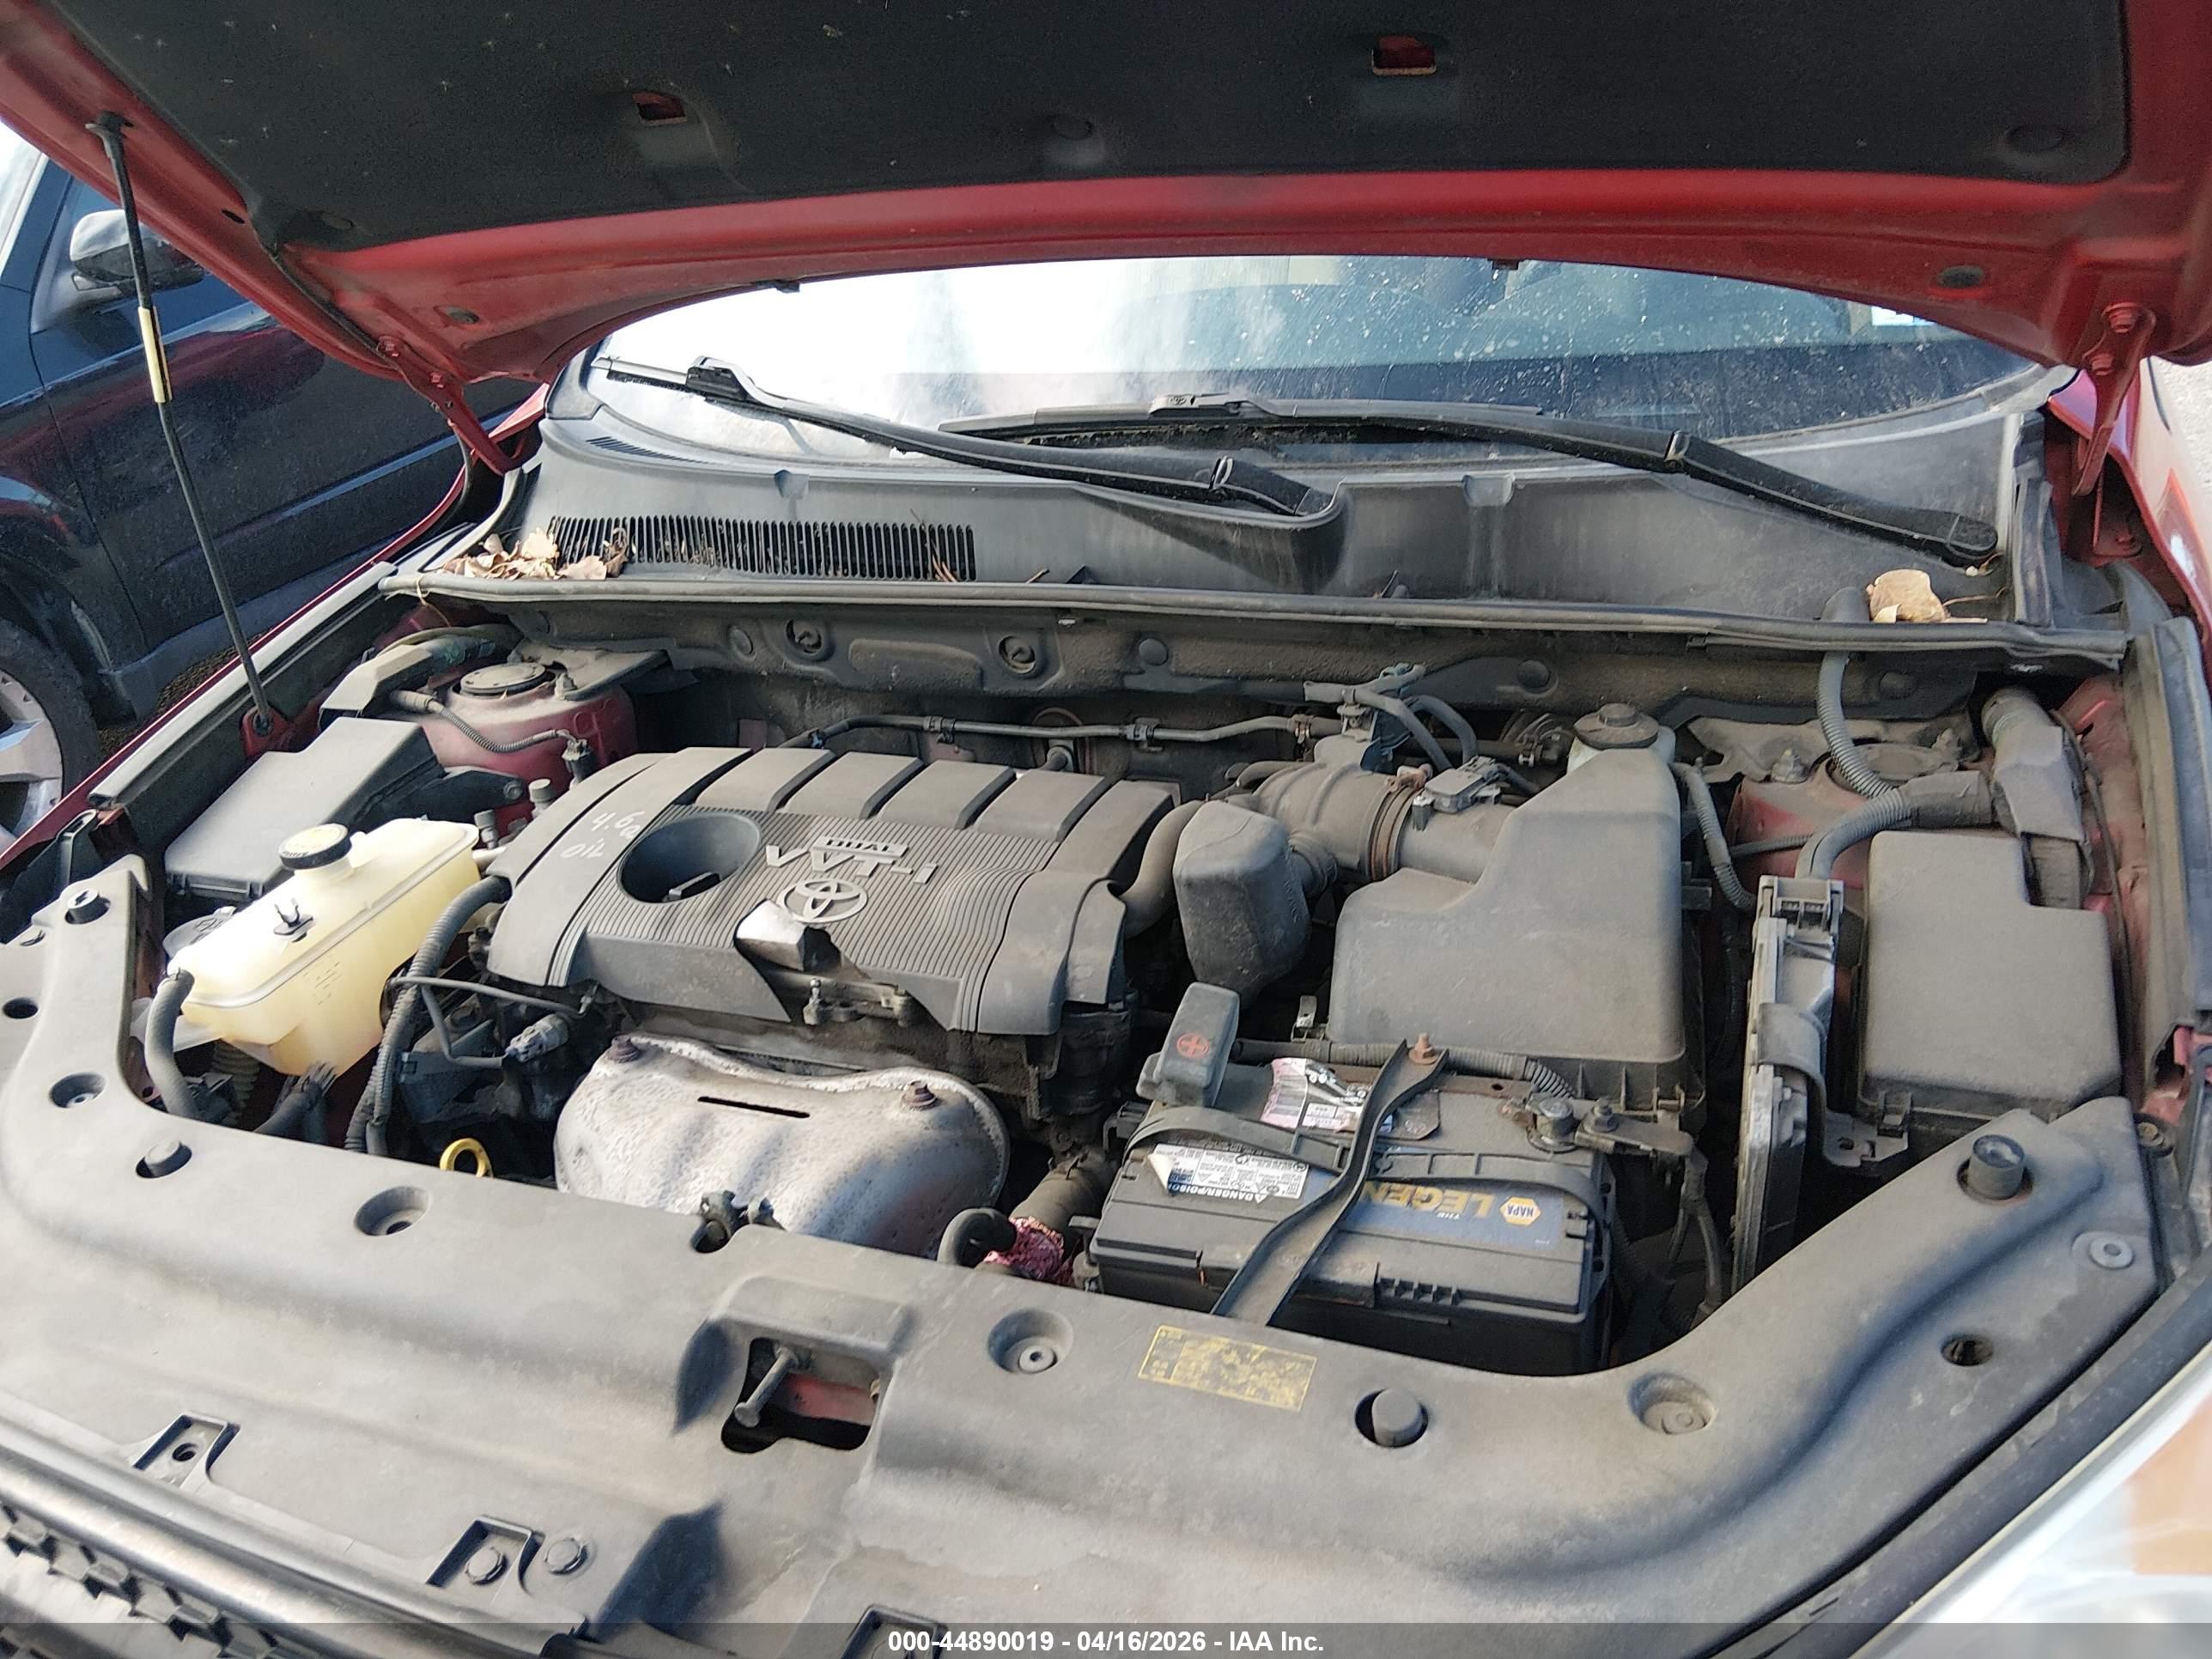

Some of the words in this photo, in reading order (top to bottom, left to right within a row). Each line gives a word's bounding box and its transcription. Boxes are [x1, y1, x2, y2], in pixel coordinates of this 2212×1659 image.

[825, 838, 895, 853] DUAL
[1358, 1181, 1495, 1218] LEGEN
[1506, 1203, 1534, 1218] NAPA
